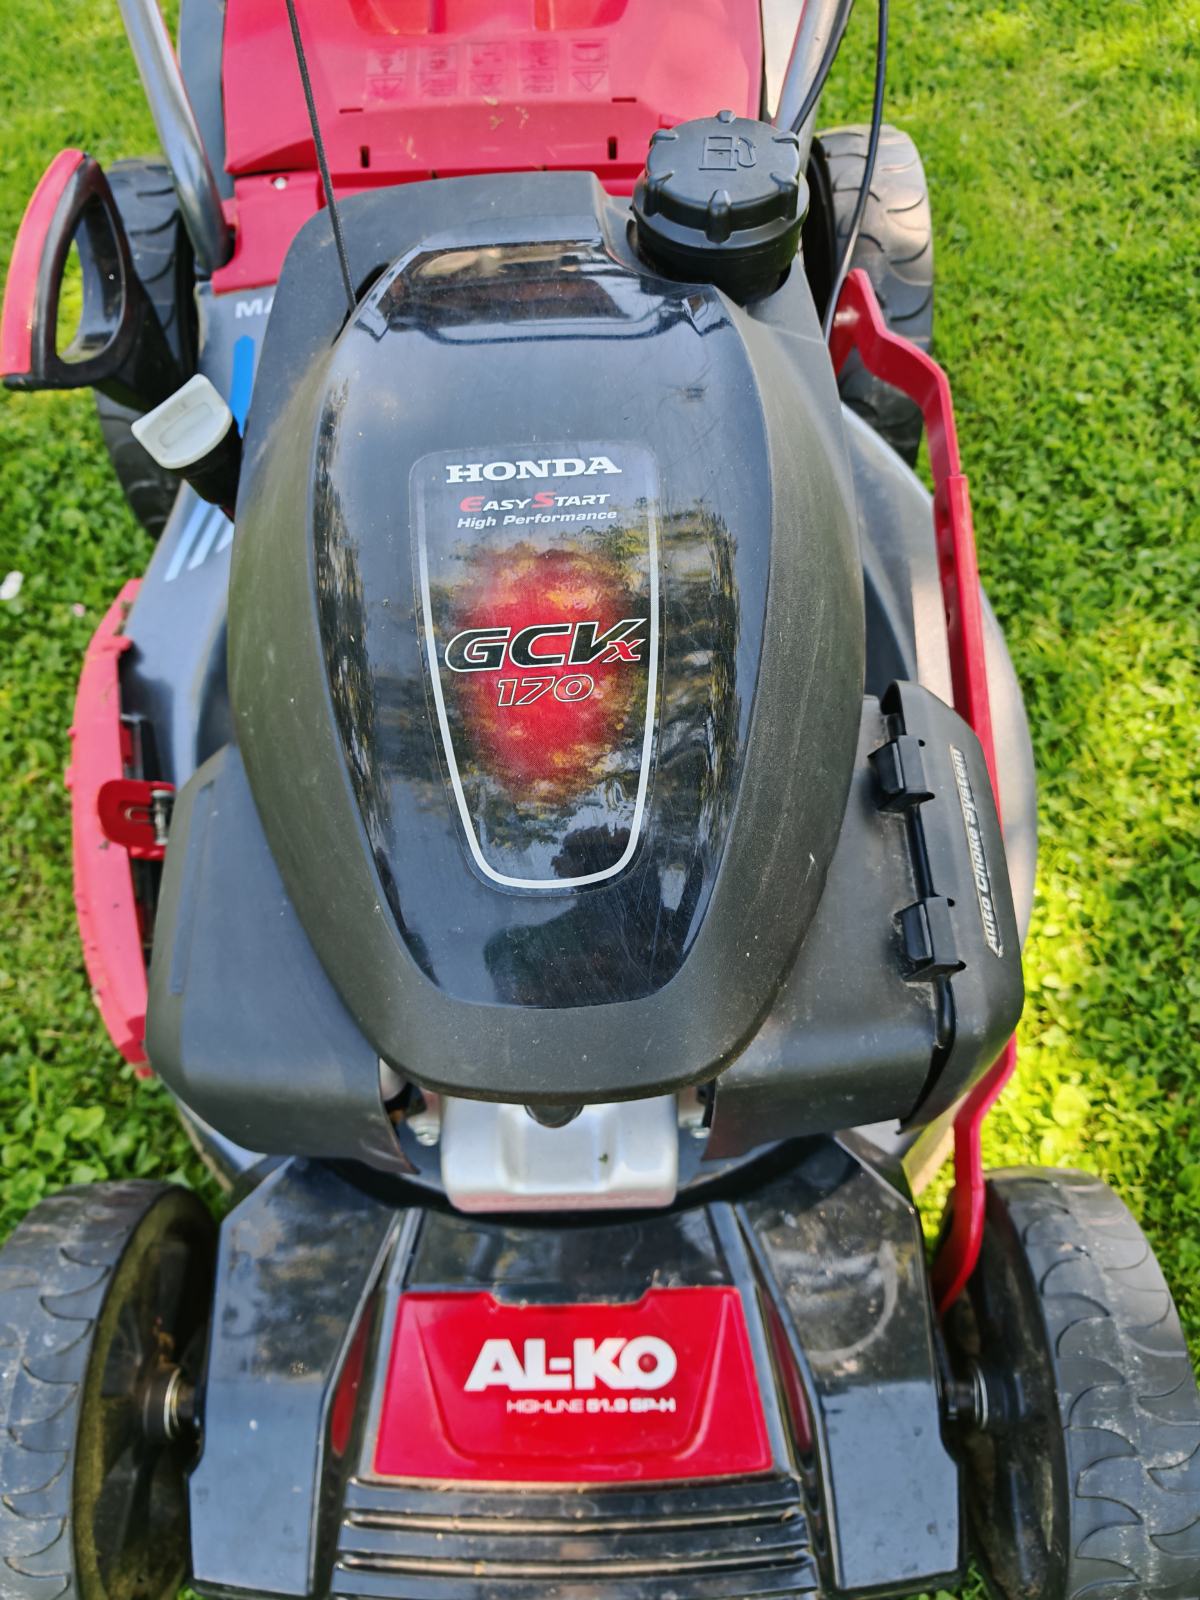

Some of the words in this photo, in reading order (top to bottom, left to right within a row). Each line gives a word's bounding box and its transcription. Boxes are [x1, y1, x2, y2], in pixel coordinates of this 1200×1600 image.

[446, 456, 622, 484] HONDA
[457, 516, 497, 530] High
[503, 510, 617, 526] Performance
[496, 673, 595, 707] 170
[952, 749, 979, 824] System
[966, 829, 990, 892] Choke
[981, 897, 1001, 952] Auto
[464, 1335, 678, 1392] AL-KO
